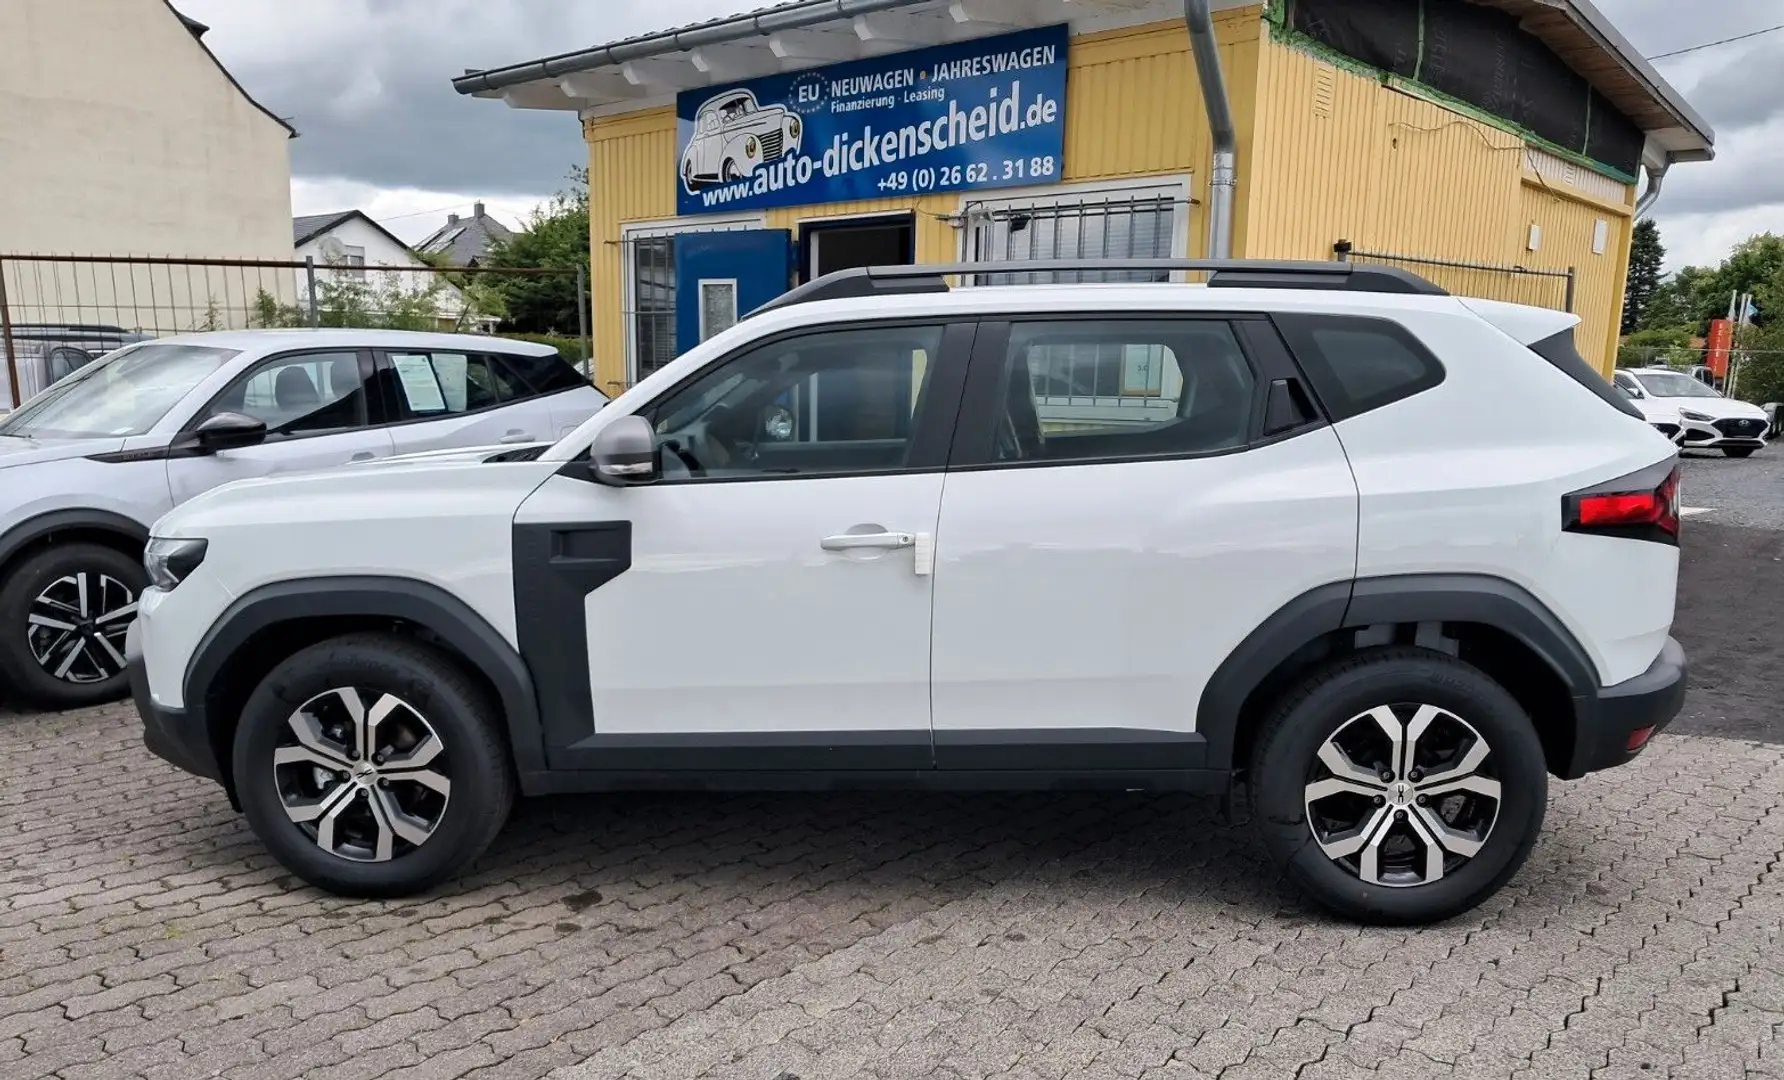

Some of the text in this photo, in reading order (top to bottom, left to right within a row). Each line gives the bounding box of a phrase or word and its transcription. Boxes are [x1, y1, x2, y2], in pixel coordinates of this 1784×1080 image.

[831, 45, 1056, 98] NEUWAGEN JAHRESWAGEN
[798, 84, 820, 103] EU
[831, 86, 945, 113] Finanzierung Leasing
[702, 80, 1057, 207] www.auto-dickenscheid.de
[877, 171, 908, 191] +49
[912, 167, 936, 192] (0)
[940, 165, 961, 186] 26
[966, 162, 988, 183] 62
[1002, 159, 1024, 180] 31
[1030, 156, 1054, 177] 88
